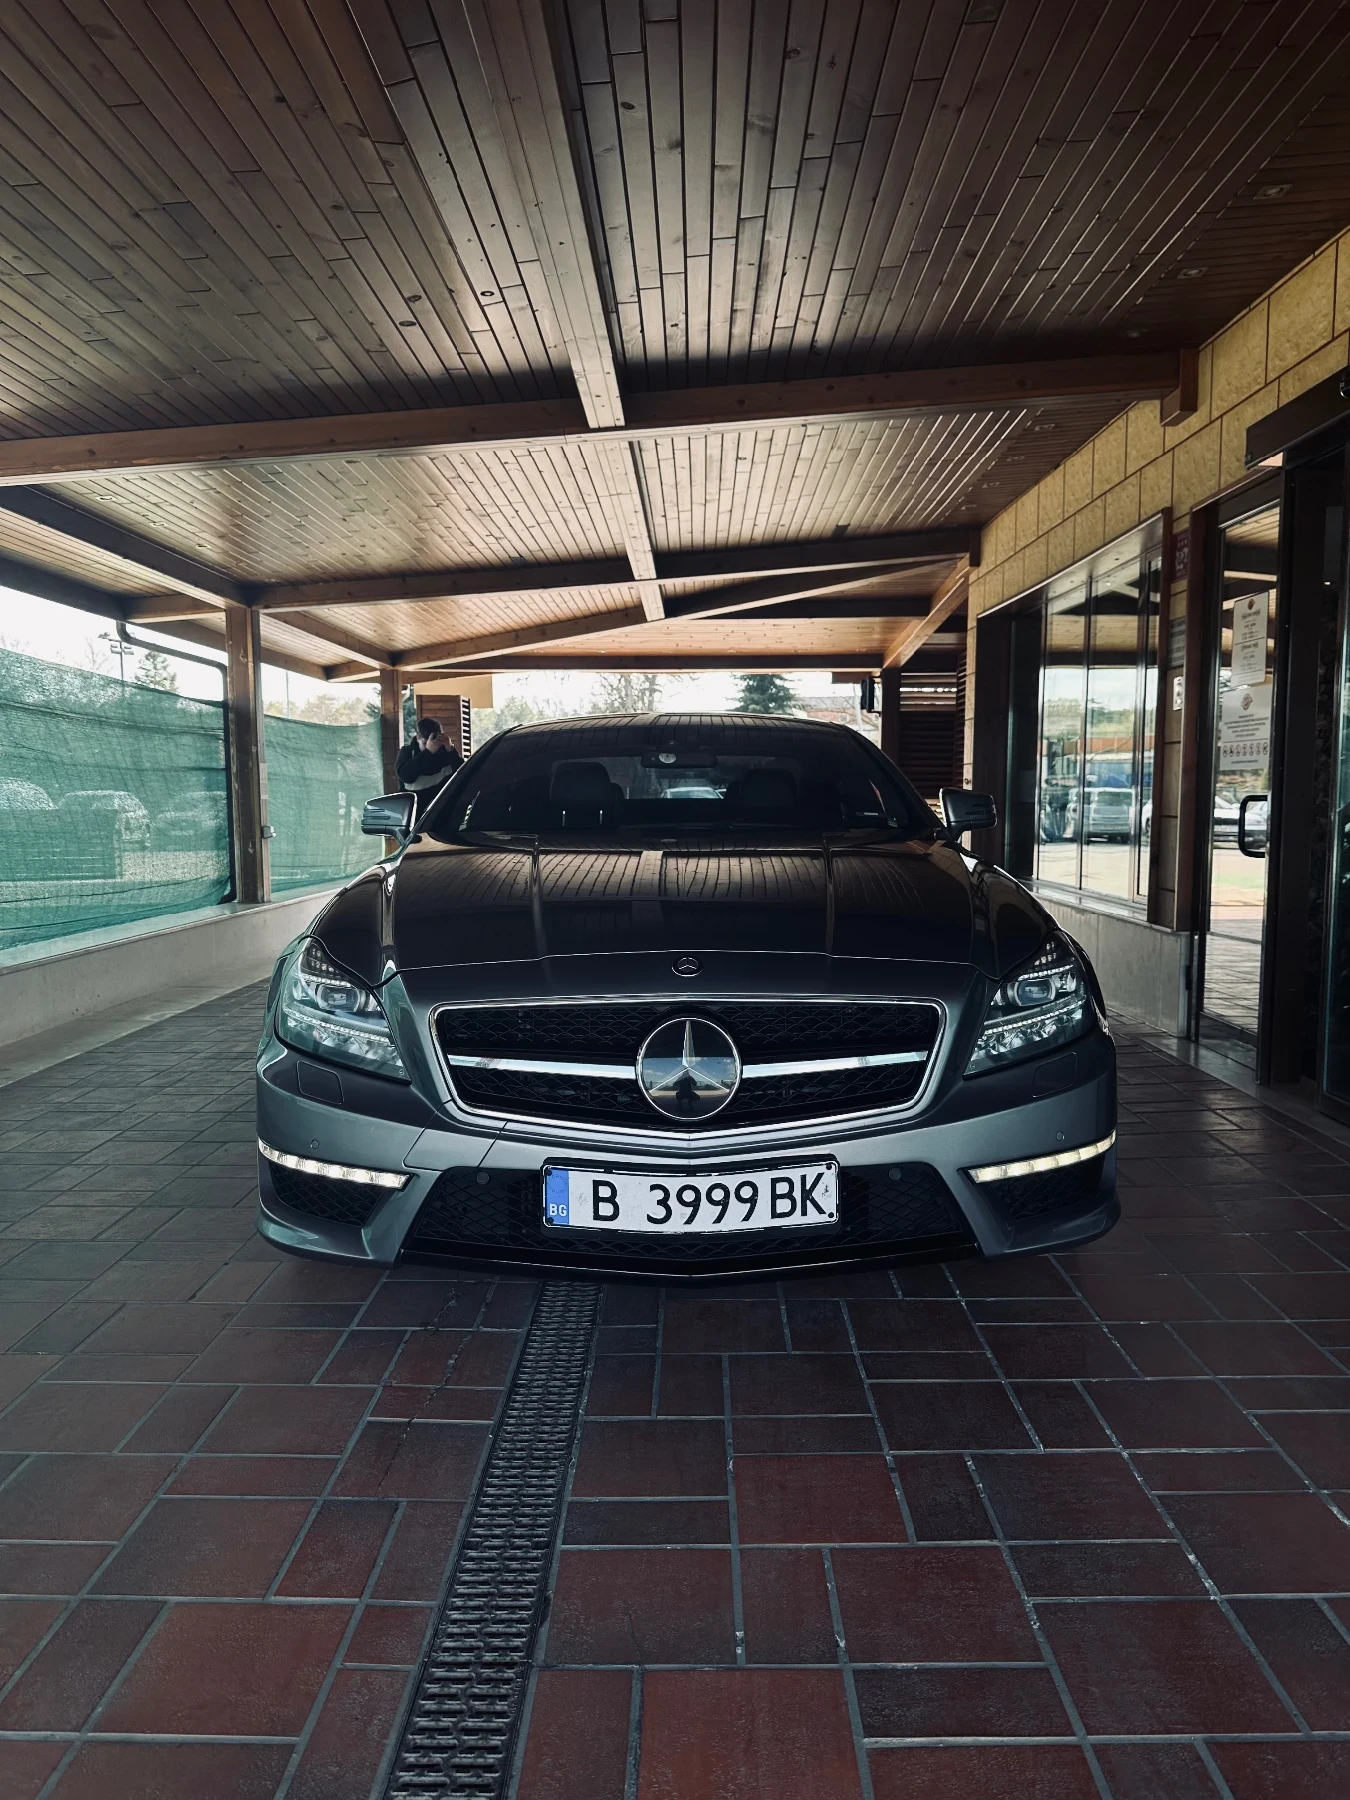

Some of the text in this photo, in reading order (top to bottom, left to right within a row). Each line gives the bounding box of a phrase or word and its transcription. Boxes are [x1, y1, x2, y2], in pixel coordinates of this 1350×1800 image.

[549, 1203, 567, 1217] BG
[592, 1172, 827, 1225] B 3999 BK
